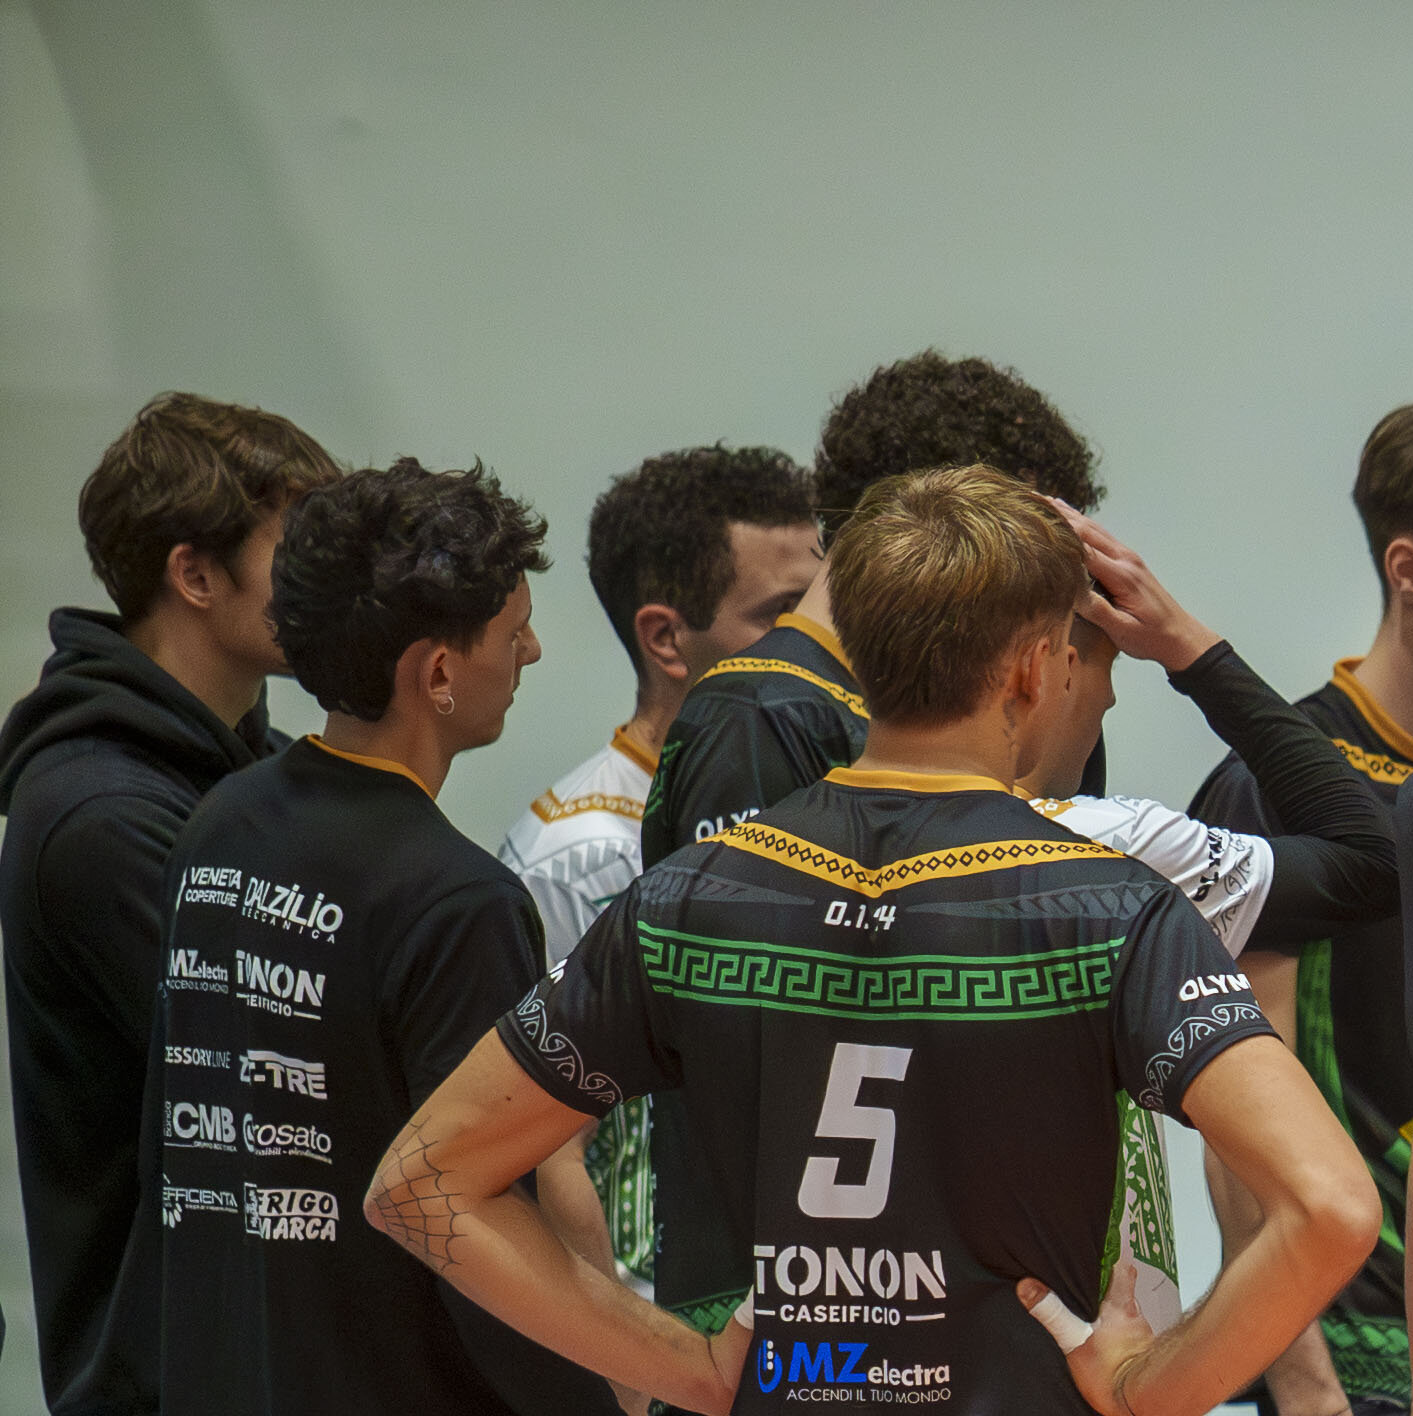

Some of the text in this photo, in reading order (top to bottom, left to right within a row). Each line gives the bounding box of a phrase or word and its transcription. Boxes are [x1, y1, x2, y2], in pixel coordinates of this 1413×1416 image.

[191, 867, 242, 889] VENETA
[173, 1102, 236, 1143] CMB
[798, 1042, 913, 1219] 5
[754, 1245, 947, 1301] TONON
[780, 1304, 900, 1326] CASEIFICIO
[787, 1387, 951, 1404] ACCENDI IL TUO MONDO
